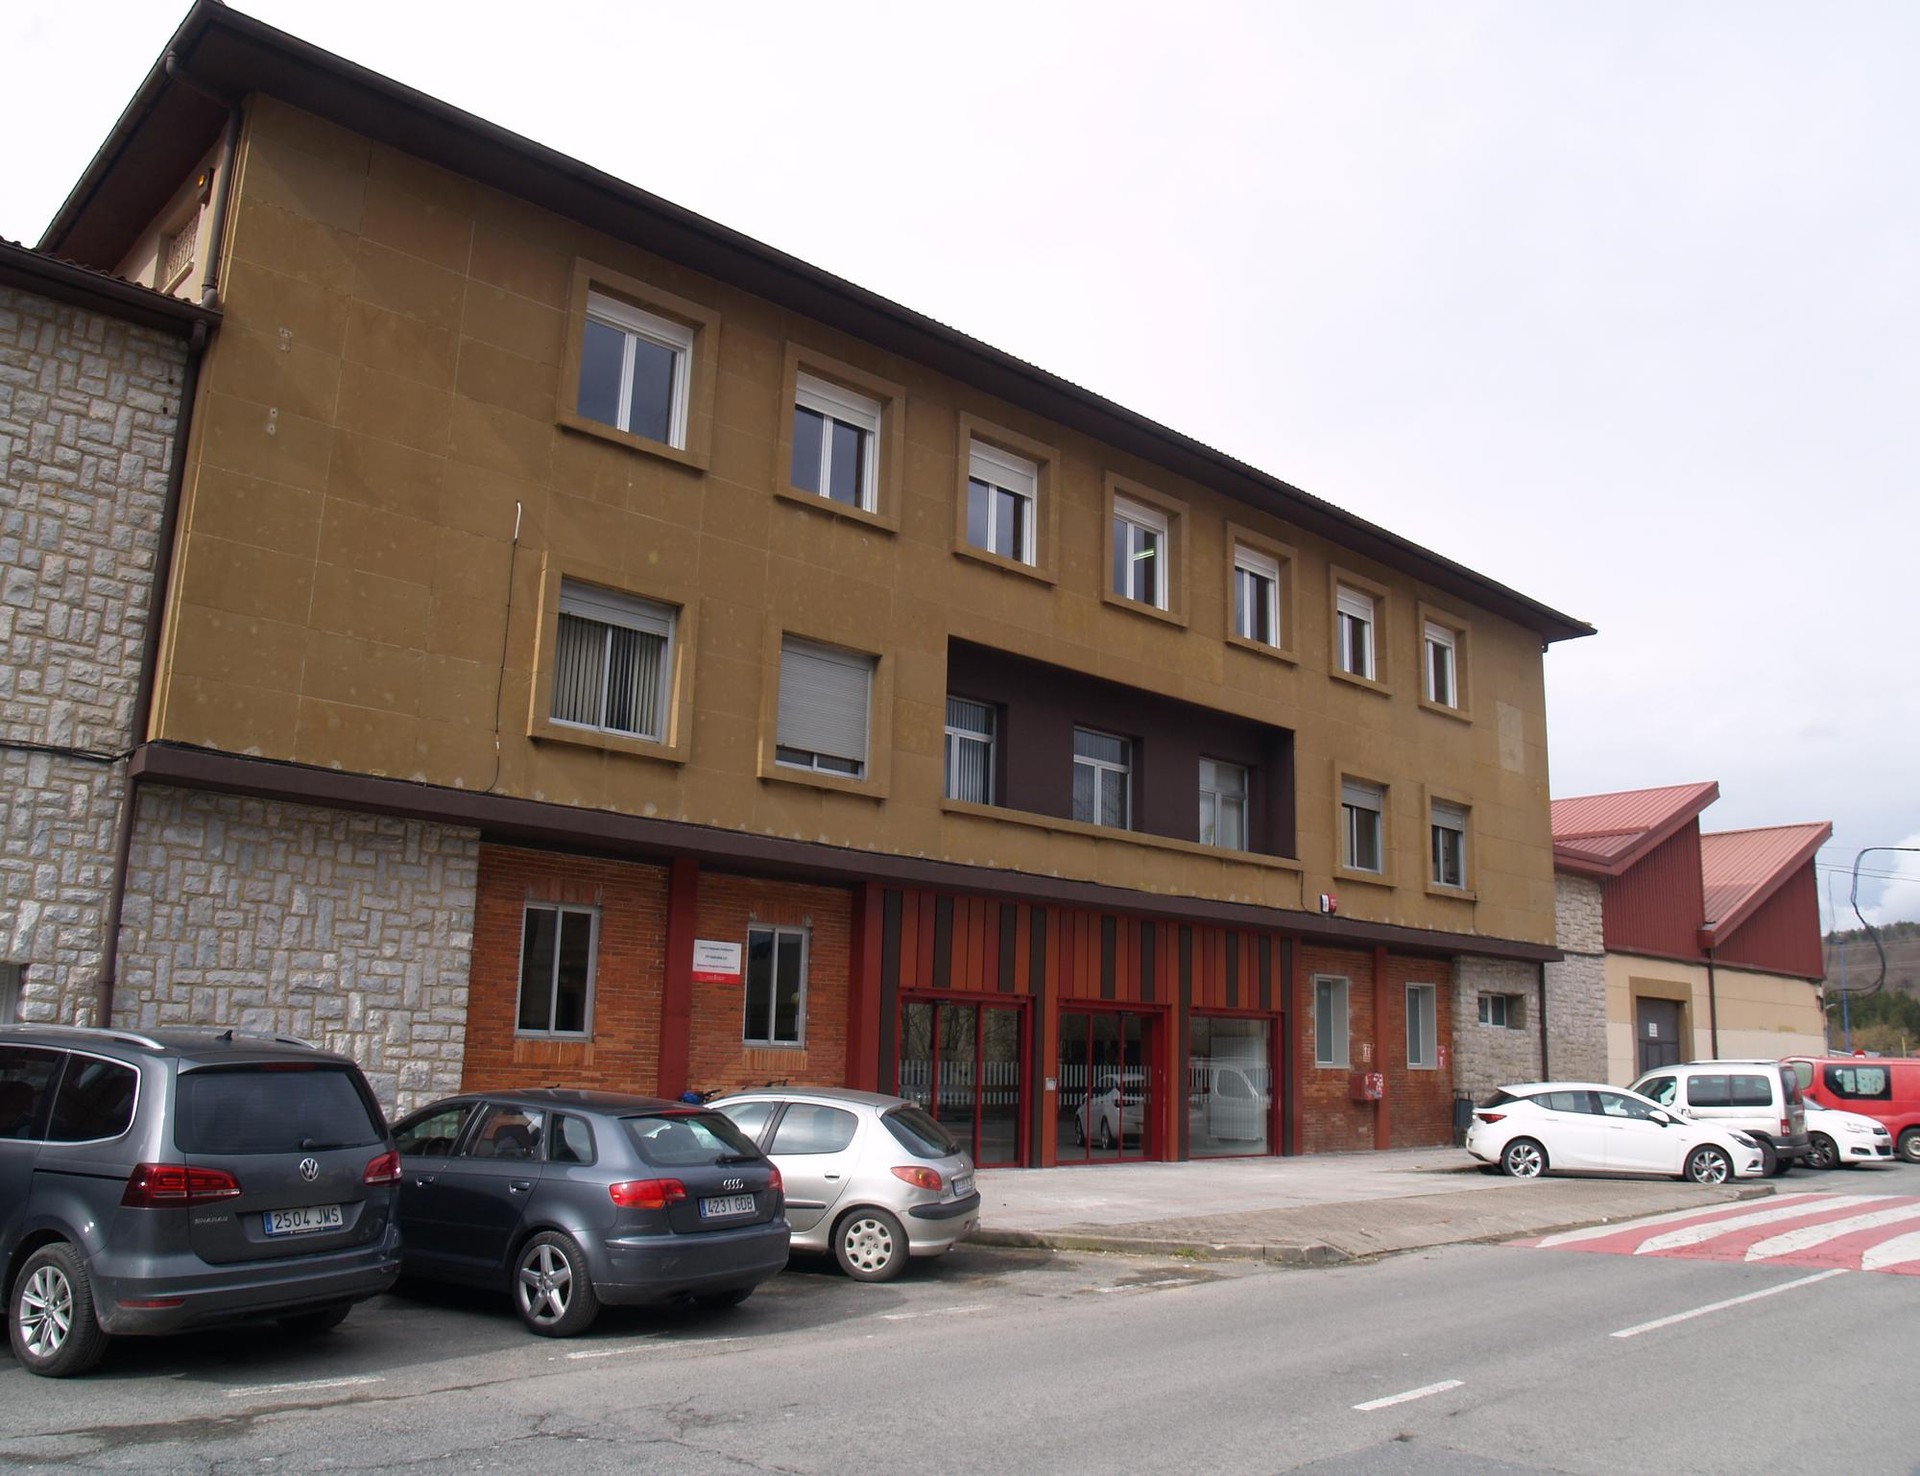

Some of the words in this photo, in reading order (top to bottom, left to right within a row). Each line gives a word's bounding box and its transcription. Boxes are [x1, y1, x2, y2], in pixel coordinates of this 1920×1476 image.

[708, 1199, 732, 1214] 4231
[735, 1196, 753, 1211] GDB
[275, 1210, 310, 1229] 2504
[316, 1207, 340, 1225] JMS
